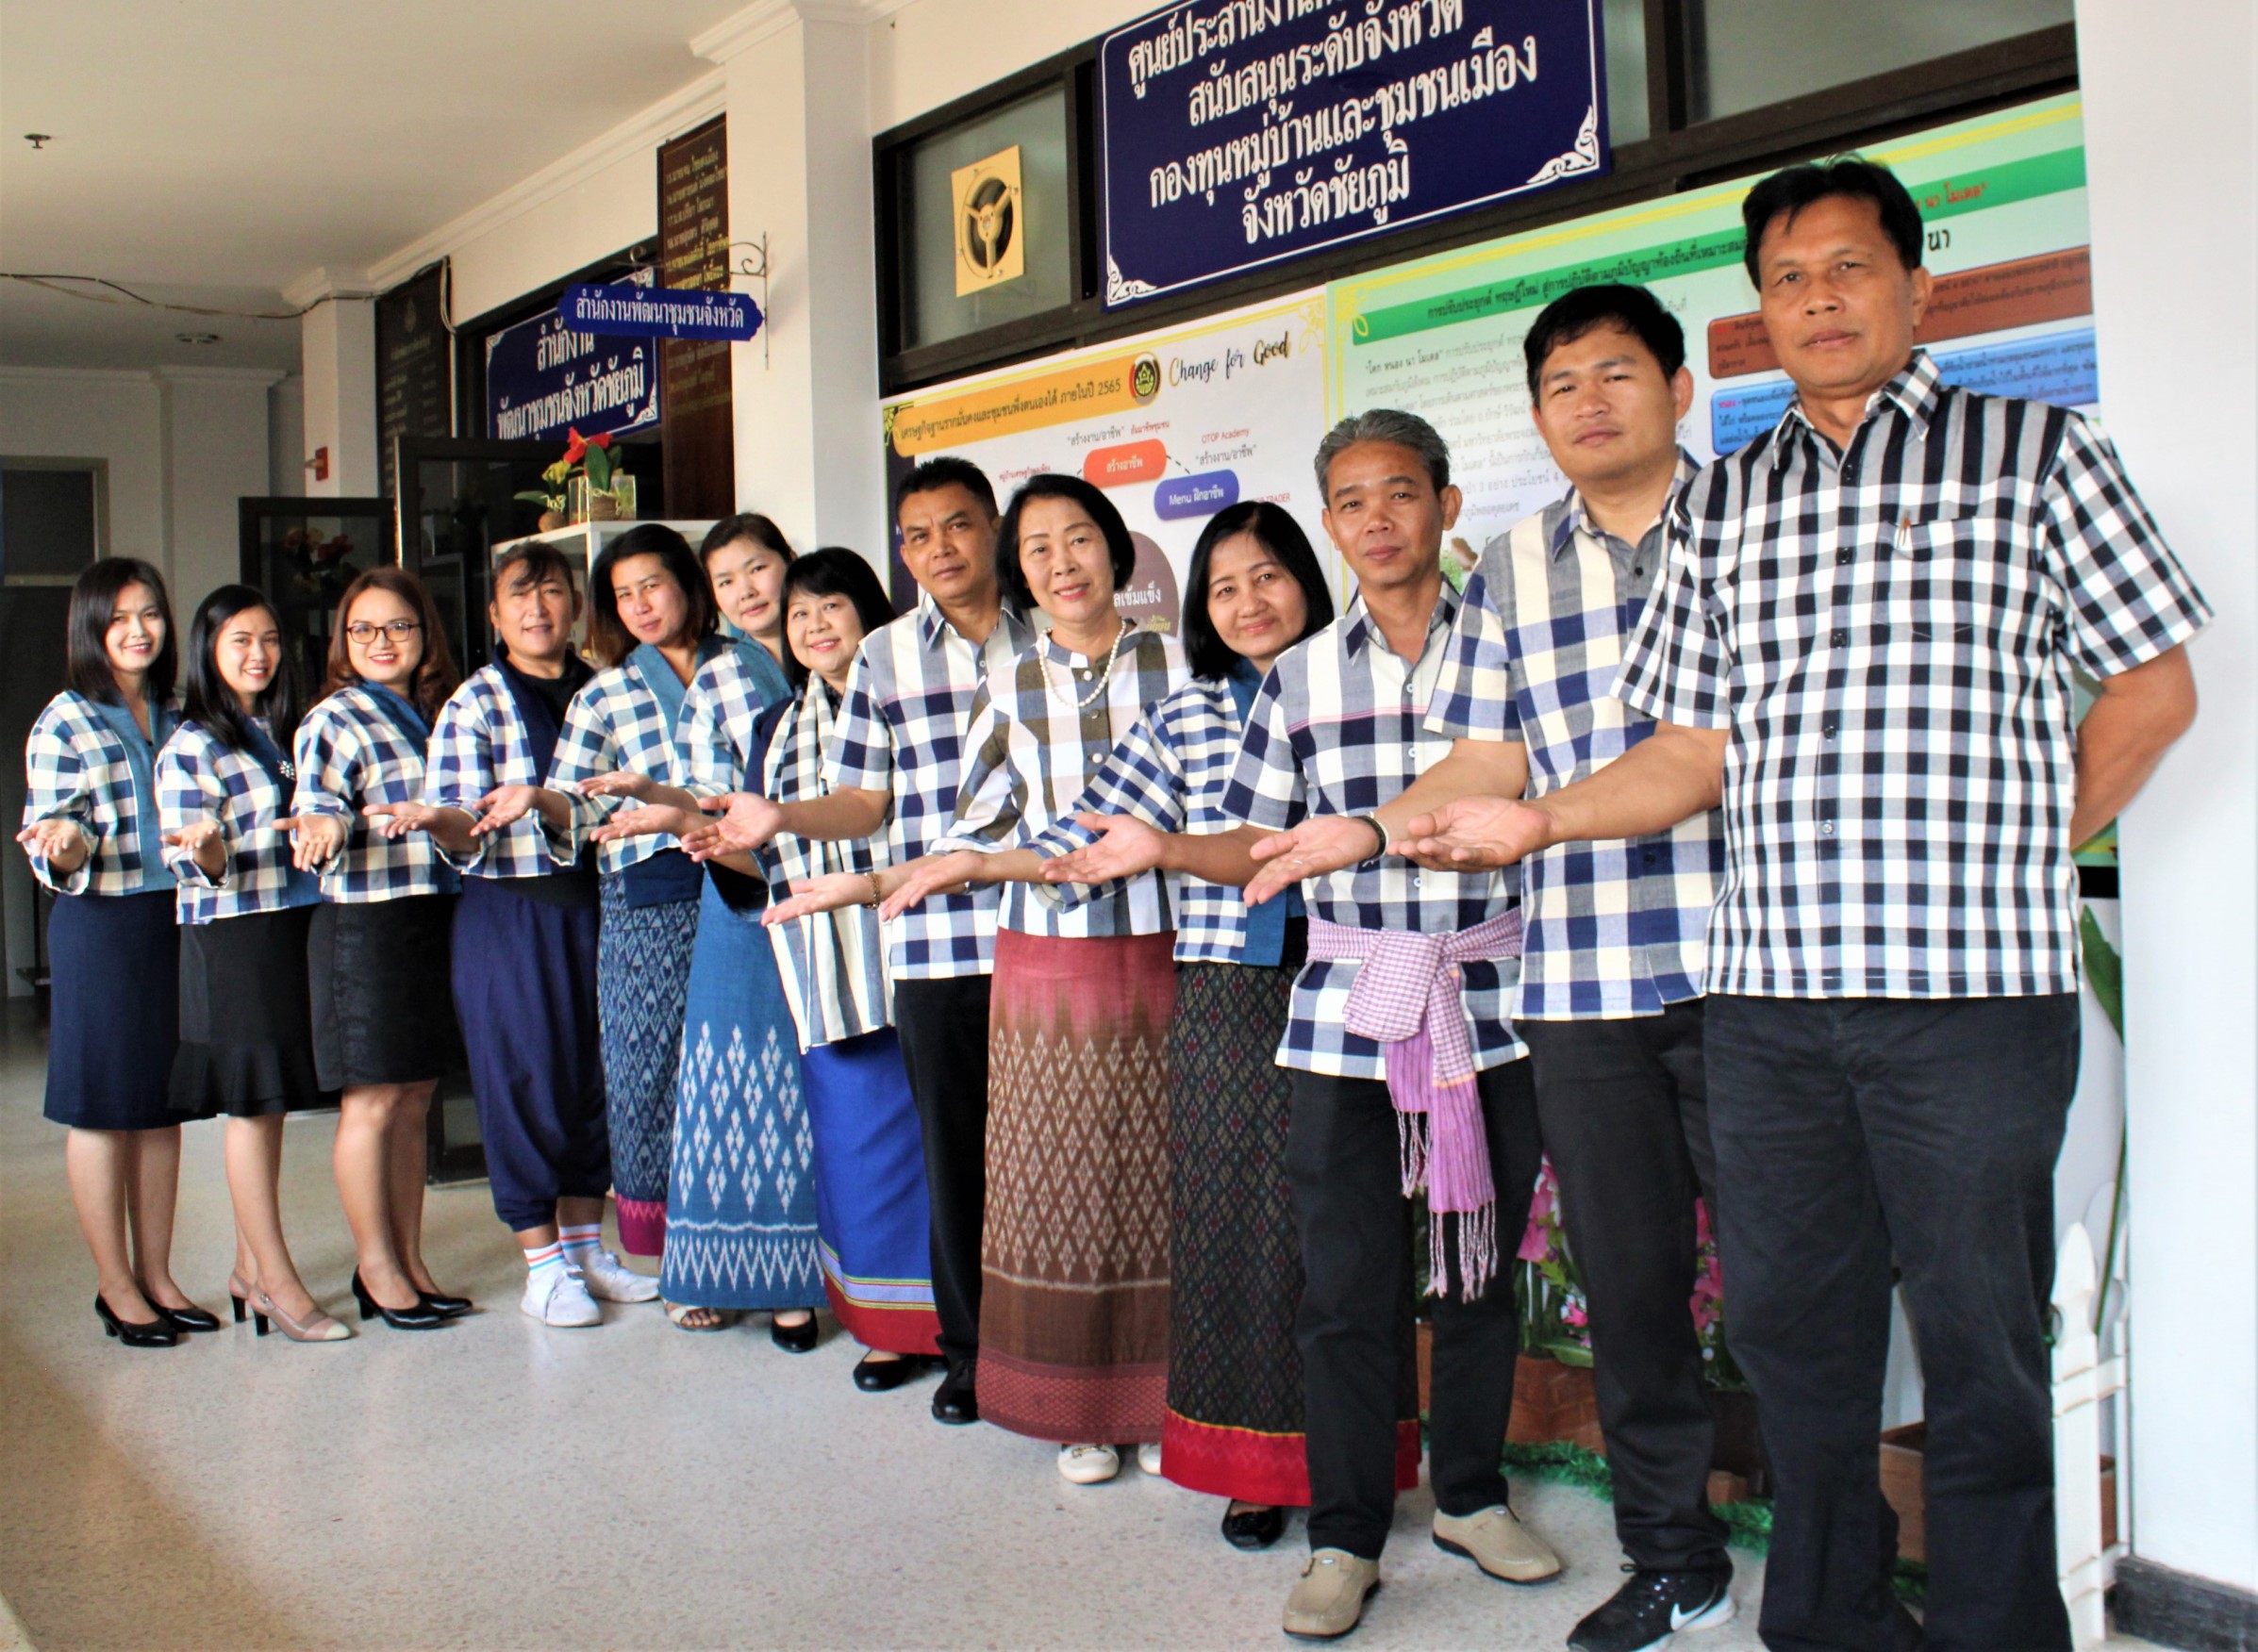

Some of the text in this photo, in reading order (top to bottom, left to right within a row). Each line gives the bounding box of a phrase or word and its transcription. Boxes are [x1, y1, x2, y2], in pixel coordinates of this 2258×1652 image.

[1150, 25, 1538, 208] กองทุนหมู่บ้านและชุมชนเมือง
[1241, 138, 1410, 245] จังหวัดชัยภูมิ
[575, 288, 744, 337] สำนักงานพัฒนาชุมชนจังหวัด
[1169, 330, 1290, 388] Change for Good
[1098, 378, 1121, 397] 2565
[1220, 428, 1251, 444] Academy
[1169, 492, 1192, 506] Menu
